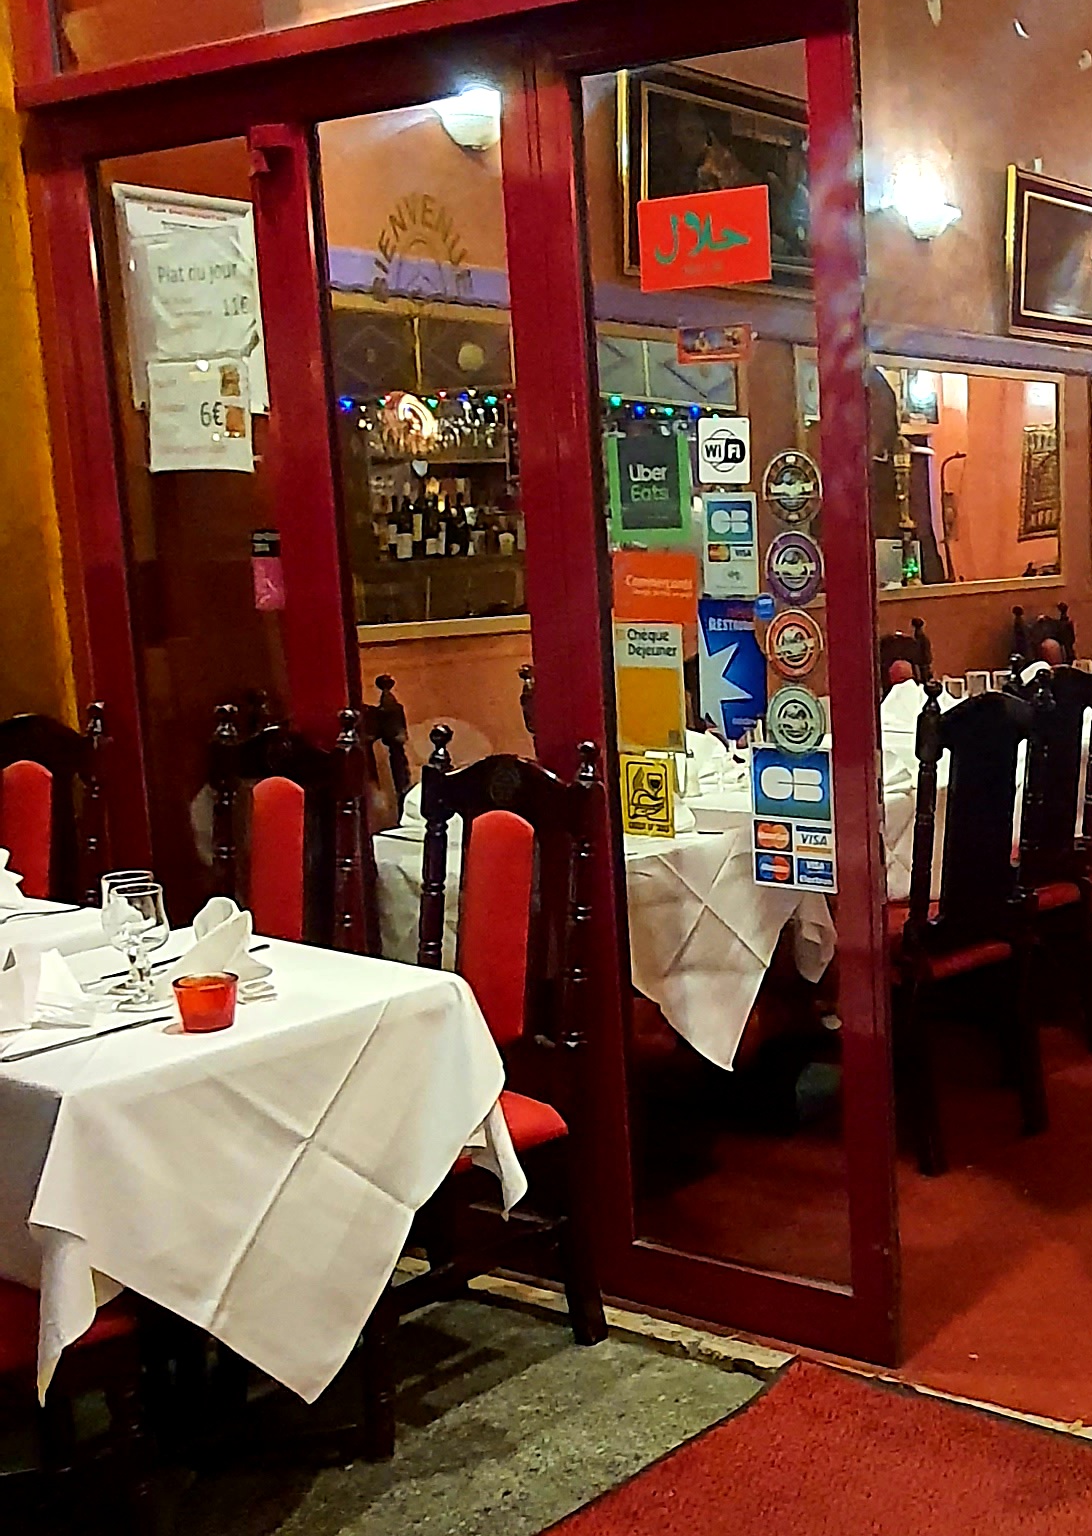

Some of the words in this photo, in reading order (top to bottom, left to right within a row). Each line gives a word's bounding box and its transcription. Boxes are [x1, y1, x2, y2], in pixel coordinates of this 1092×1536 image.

[654, 211, 751, 265] حلال
[157, 264, 184, 284] Plat
[200, 401, 224, 428] 6€
[629, 464, 668, 482] Uber
[631, 485, 670, 502] Eats
[761, 766, 825, 803] CB
[800, 833, 828, 845] VISA
